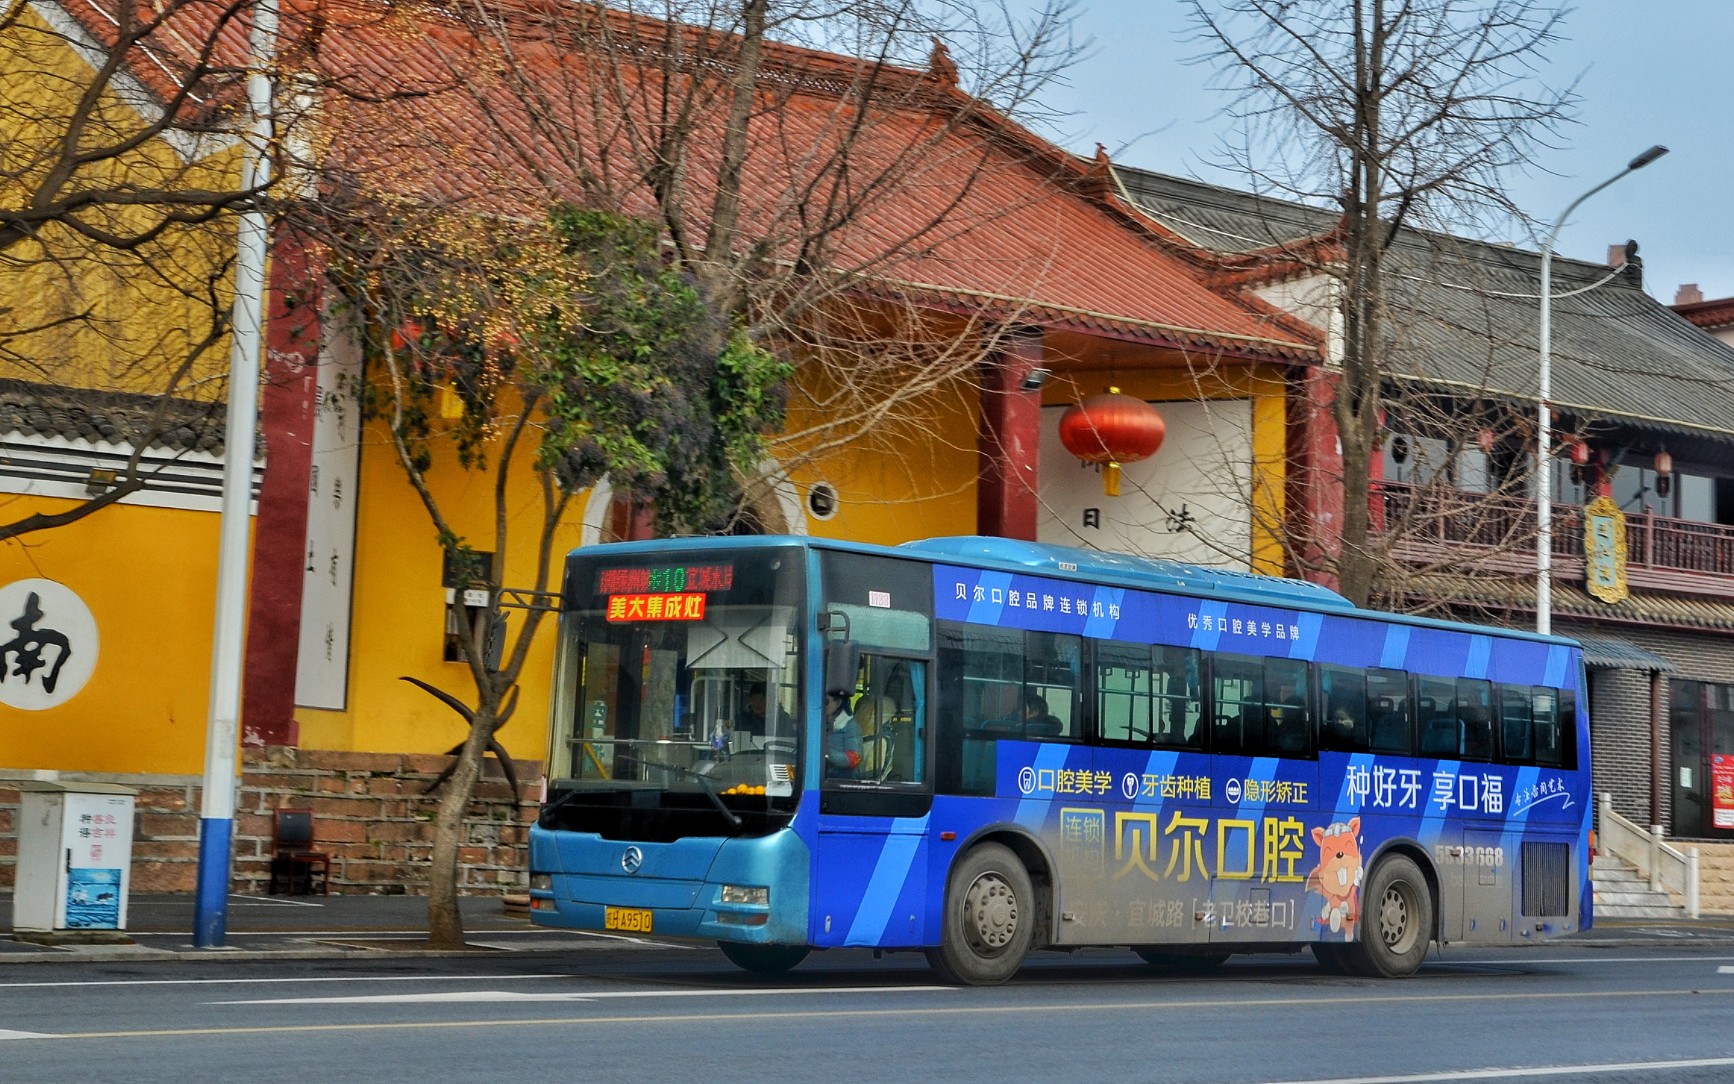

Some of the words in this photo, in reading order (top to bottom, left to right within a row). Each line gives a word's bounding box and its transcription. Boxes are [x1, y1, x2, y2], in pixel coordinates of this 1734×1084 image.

[609, 595, 702, 619] 美大集成灶
[955, 582, 1121, 621] 贝尔口腔品牌连锁机构
[1187, 612, 1300, 641] 优秀口腔美学品牌
[0, 591, 71, 694] 南
[1038, 768, 1113, 796] 口腔美学
[1141, 773, 1212, 800] 牙齿种植
[1243, 778, 1309, 804] 隐形矫正
[1346, 764, 1422, 809] 种好牙
[1433, 770, 1503, 814] 享口福
[1065, 815, 1100, 843] 连锁
[1113, 810, 1304, 883] 贝尔口腔
